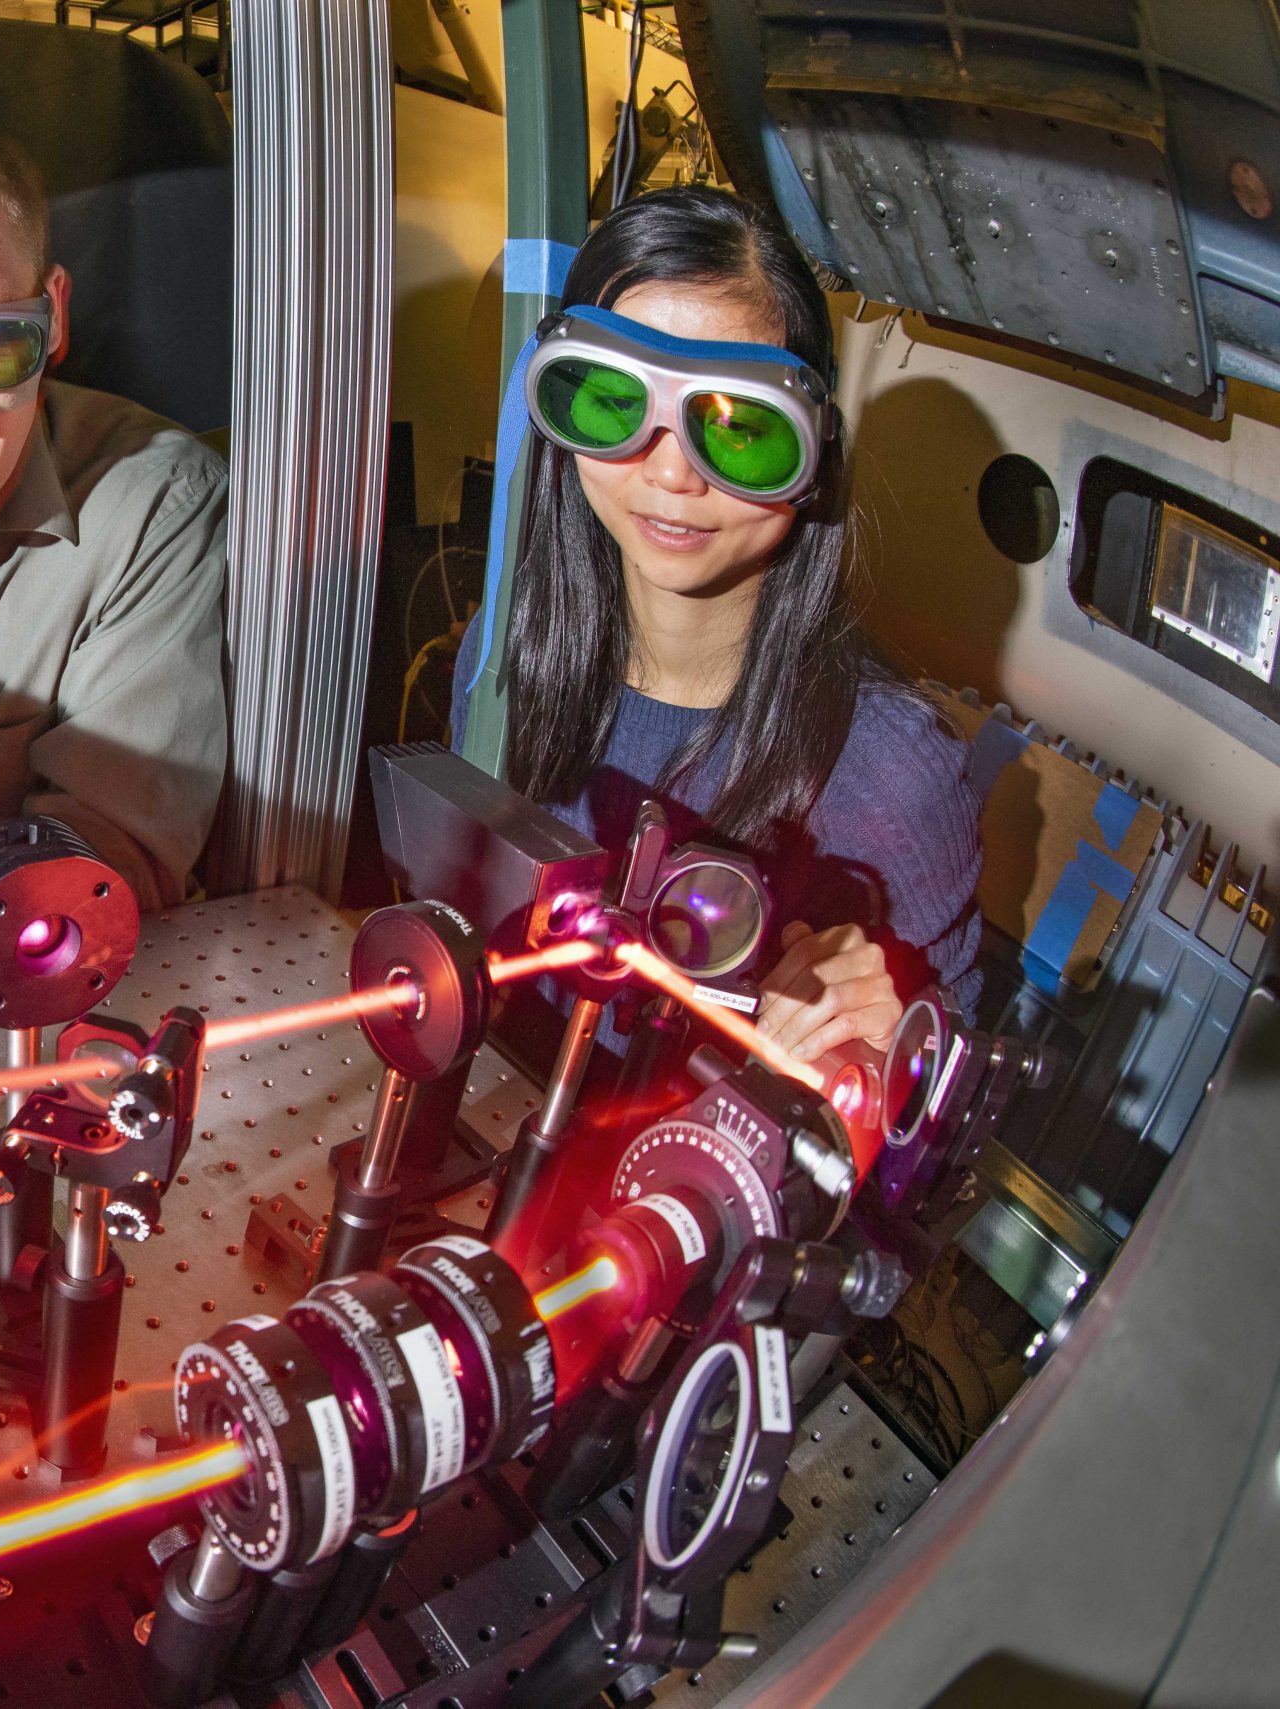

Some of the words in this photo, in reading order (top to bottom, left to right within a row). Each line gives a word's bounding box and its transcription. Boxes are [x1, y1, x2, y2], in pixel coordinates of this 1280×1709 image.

[330, 1290, 406, 1388] THORLABS
[432, 1257, 502, 1334] THORLABS
[226, 1340, 290, 1427] THORLABS
